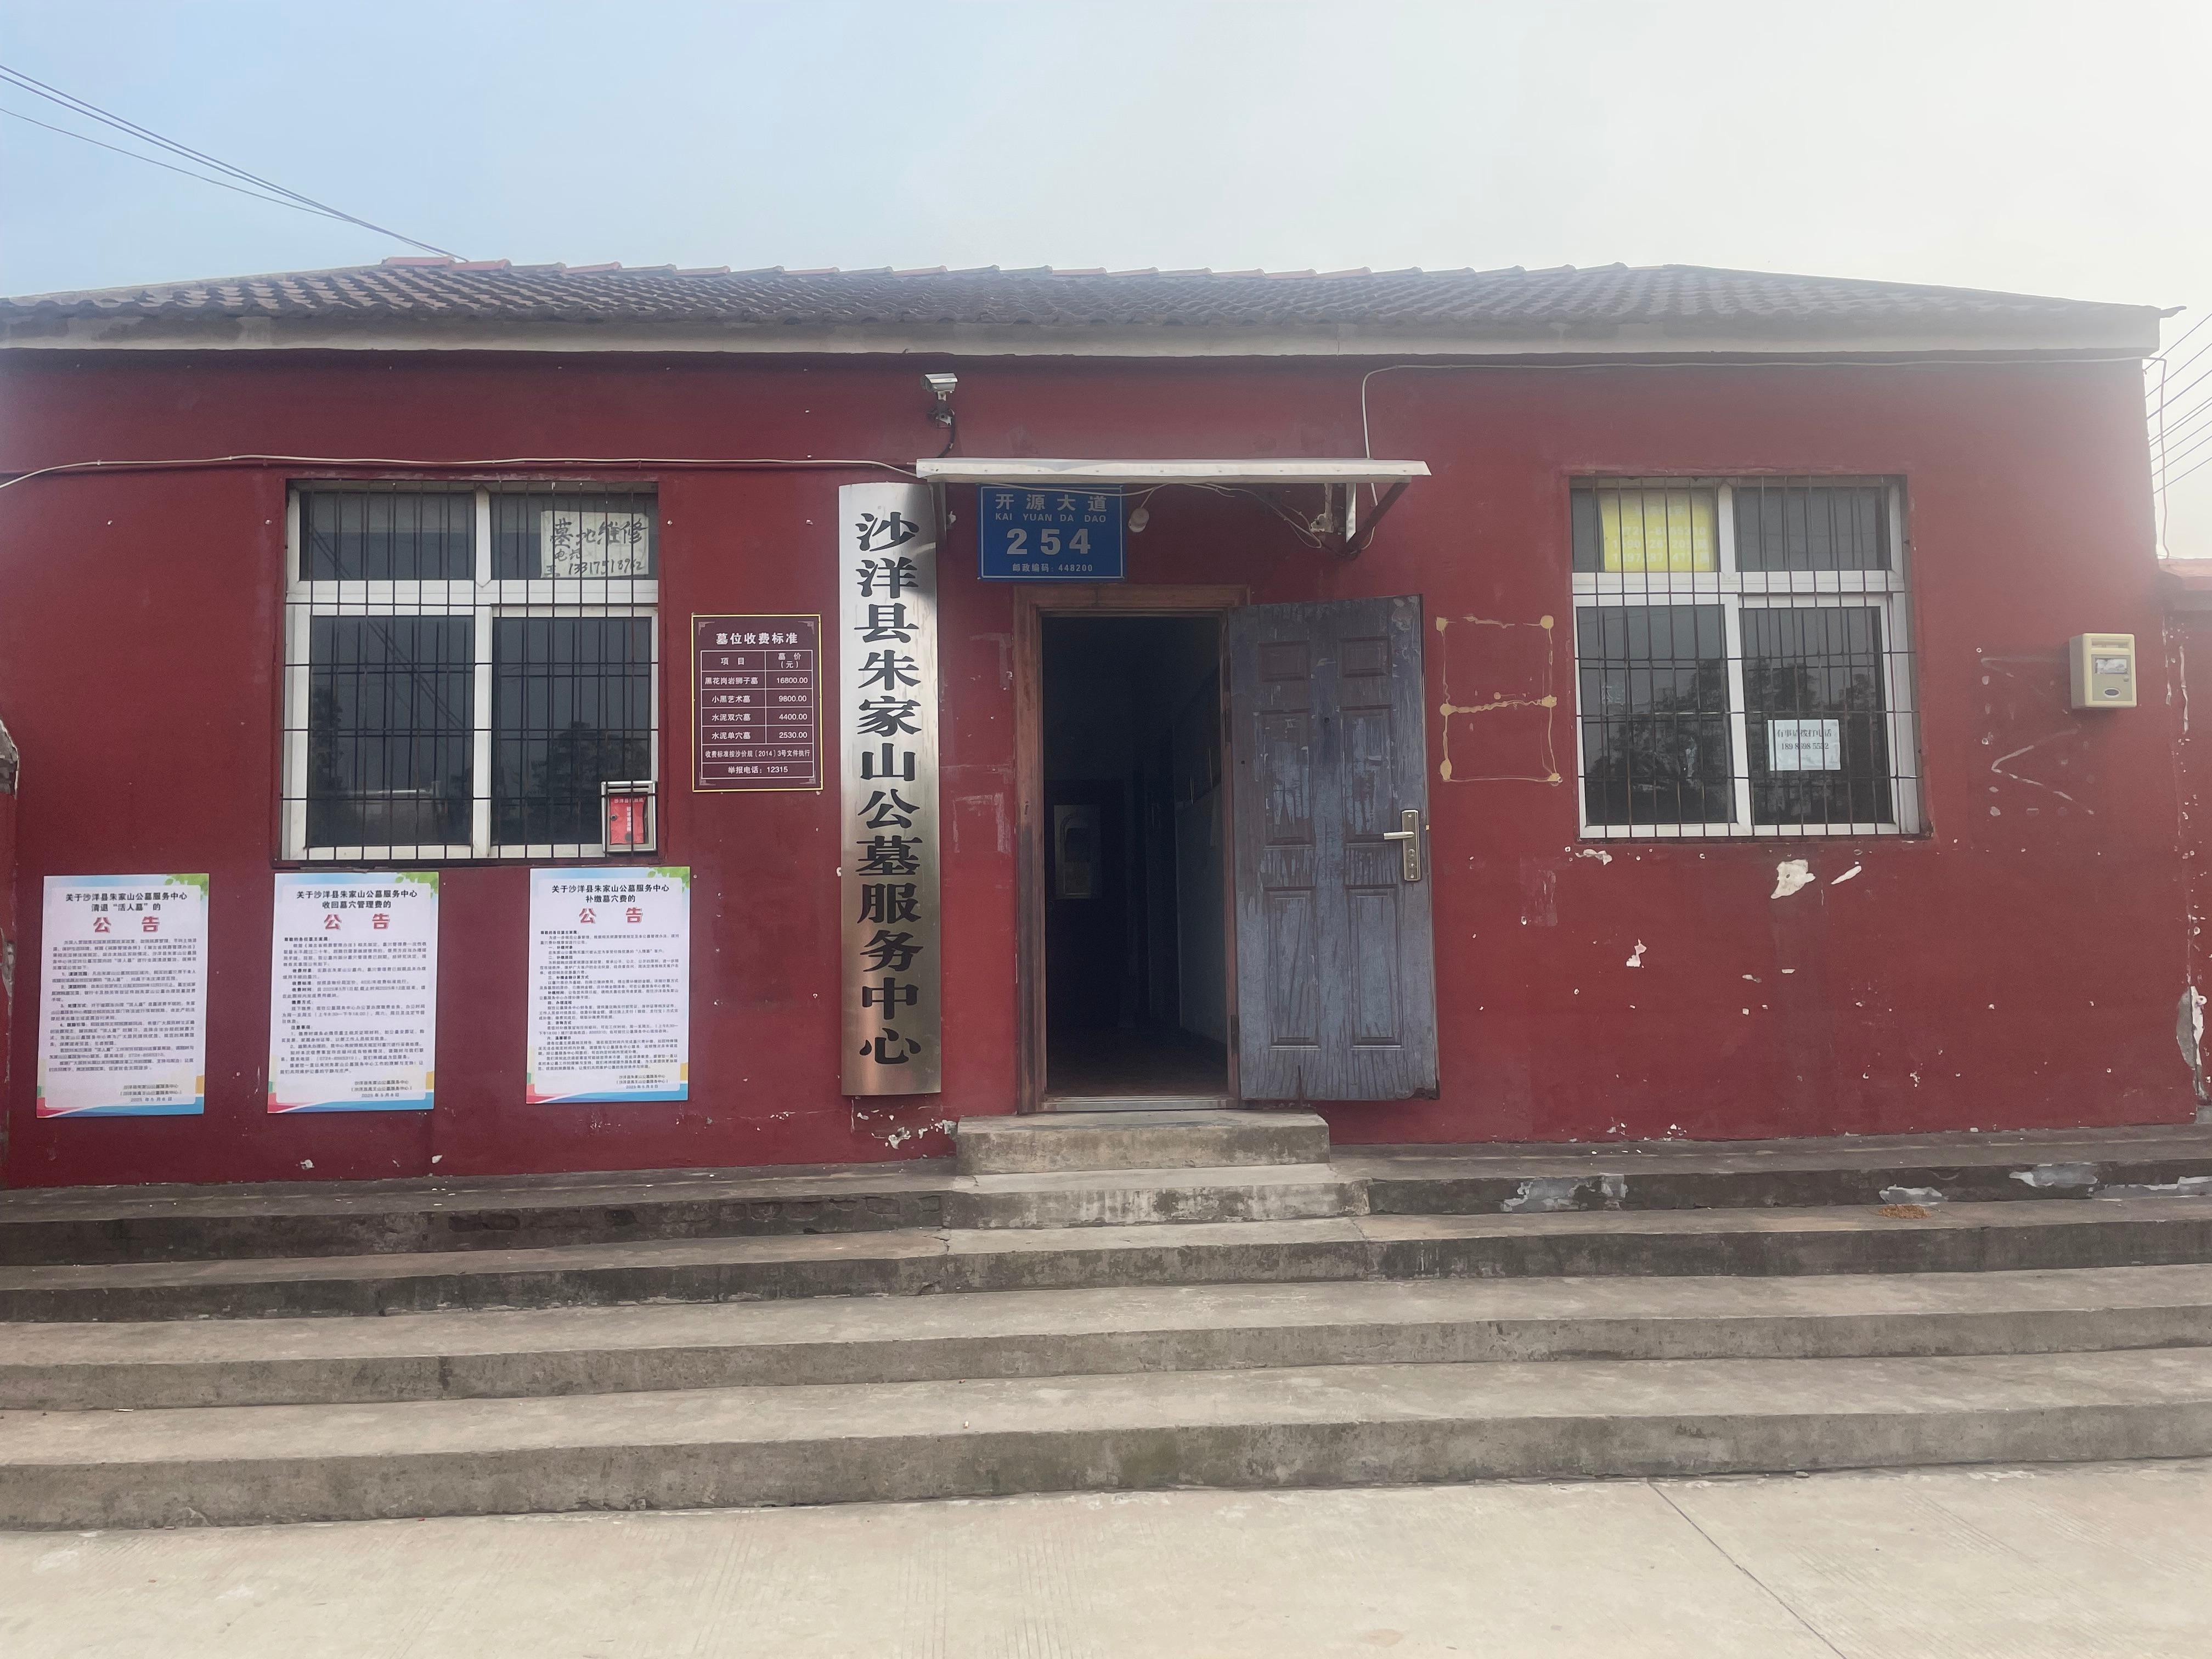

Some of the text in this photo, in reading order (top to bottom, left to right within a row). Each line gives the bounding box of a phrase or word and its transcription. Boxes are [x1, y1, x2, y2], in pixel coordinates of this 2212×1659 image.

[995, 494, 1107, 512] 开源大道
[1085, 515, 1106, 523] DAO
[550, 518, 648, 549] 墓地维修
[1006, 528, 1091, 555] 254
[716, 633, 798, 645] 墓位收费标准
[854, 512, 922, 1066] 沙洋县朱家山公墓服务中心
[296, 890, 417, 899] 关于沙洋县朱家山公墓服务中心
[552, 884, 669, 893] 关于沙洋县朱家山公墓服务中心
[66, 892, 187, 901] 关于沙洋县朱家山公墓服务中心
[585, 895, 635, 903] 补缴墓穴费的
[322, 900, 391, 909] 收回墓穴管理费的
[324, 913, 390, 930] 公告
[579, 907, 643, 924] 公告
[93, 916, 159, 933] 公告
